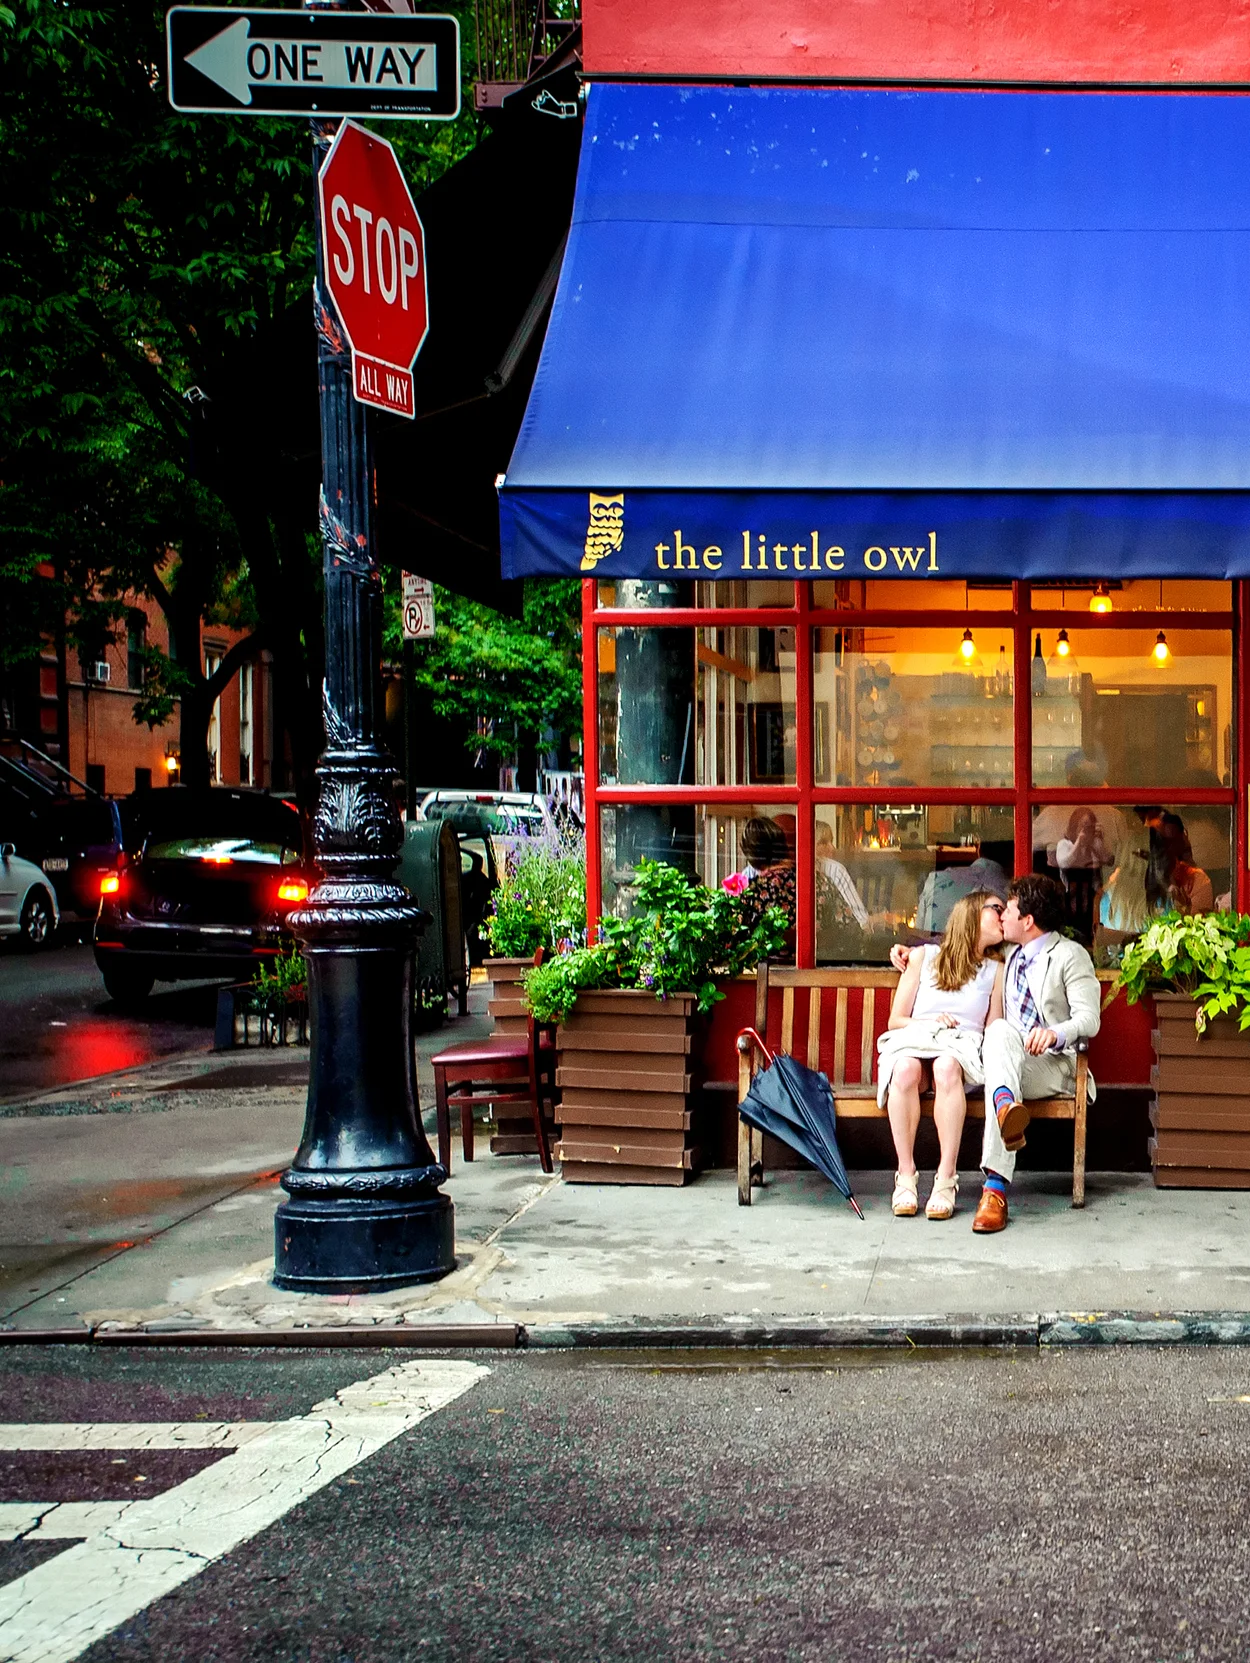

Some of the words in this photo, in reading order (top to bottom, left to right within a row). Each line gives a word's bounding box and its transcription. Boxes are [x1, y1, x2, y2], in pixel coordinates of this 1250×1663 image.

[246, 43, 324, 82] ONE
[344, 46, 426, 85] WAY
[331, 194, 419, 312] STOP
[360, 364, 382, 398] ALL
[385, 373, 409, 406] WAY
[654, 530, 723, 570] the
[740, 530, 845, 571] little
[863, 531, 940, 571] owl
